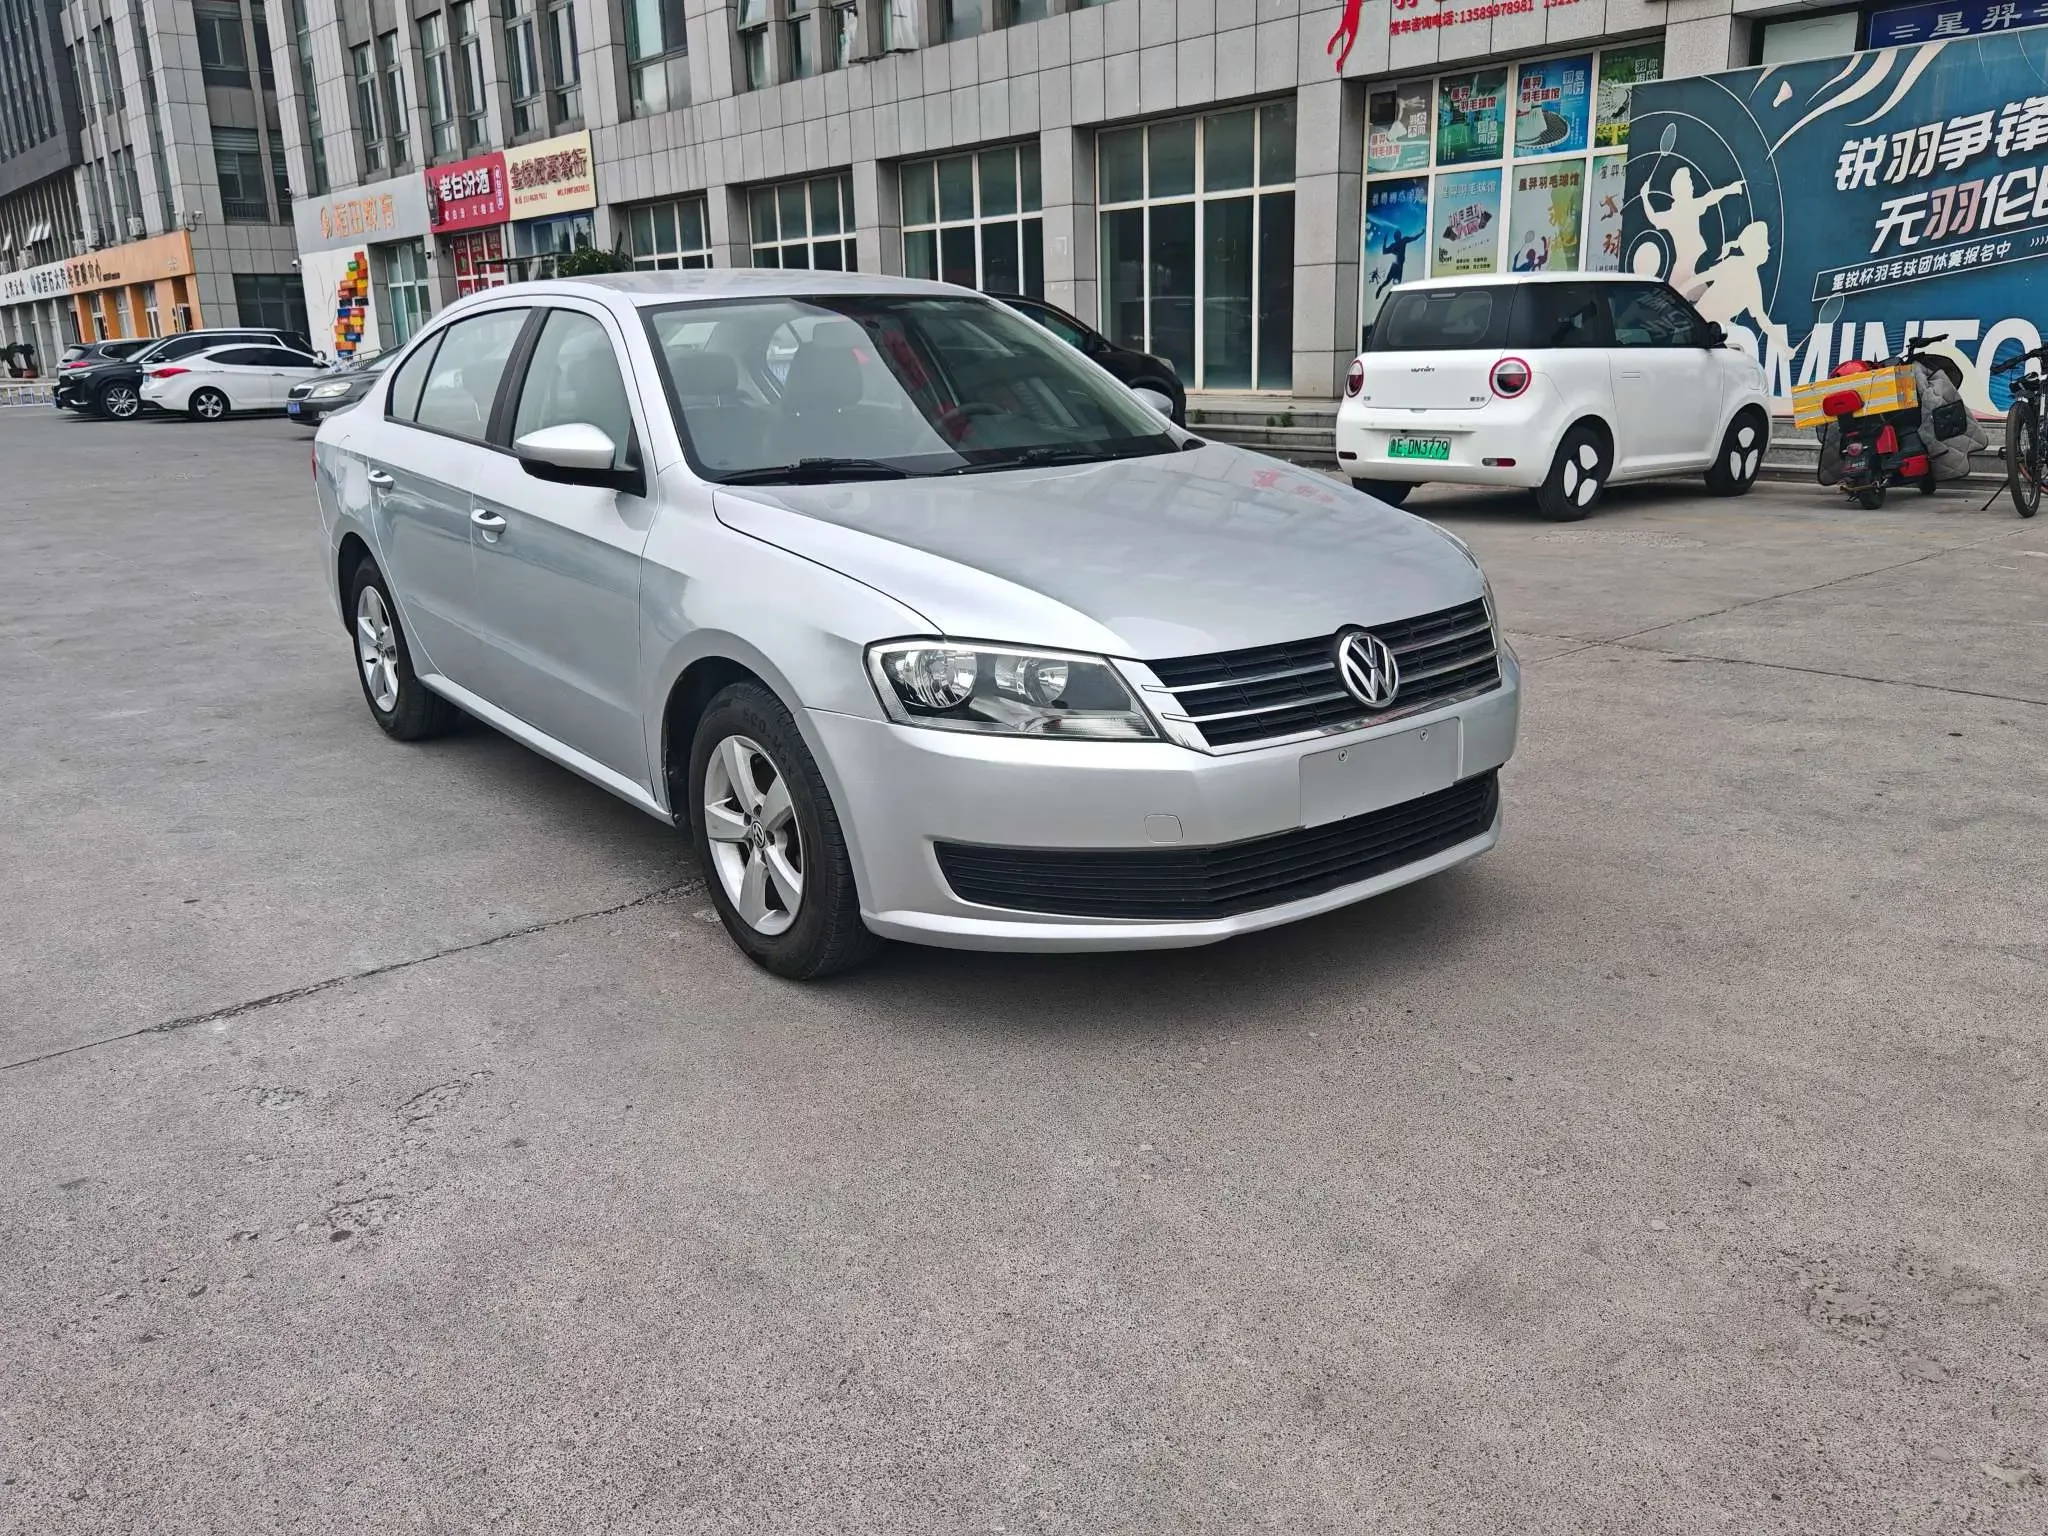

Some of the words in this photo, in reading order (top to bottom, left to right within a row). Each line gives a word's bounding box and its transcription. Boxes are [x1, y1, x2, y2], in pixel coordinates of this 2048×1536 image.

[1834, 97, 2048, 192] 锐羽争锋
[440, 168, 491, 202] 老白汾酒
[1519, 171, 1580, 192] 星羿羽毛球馆
[1831, 239, 2012, 292] 星锐杯羽毛球团体赛报名中
